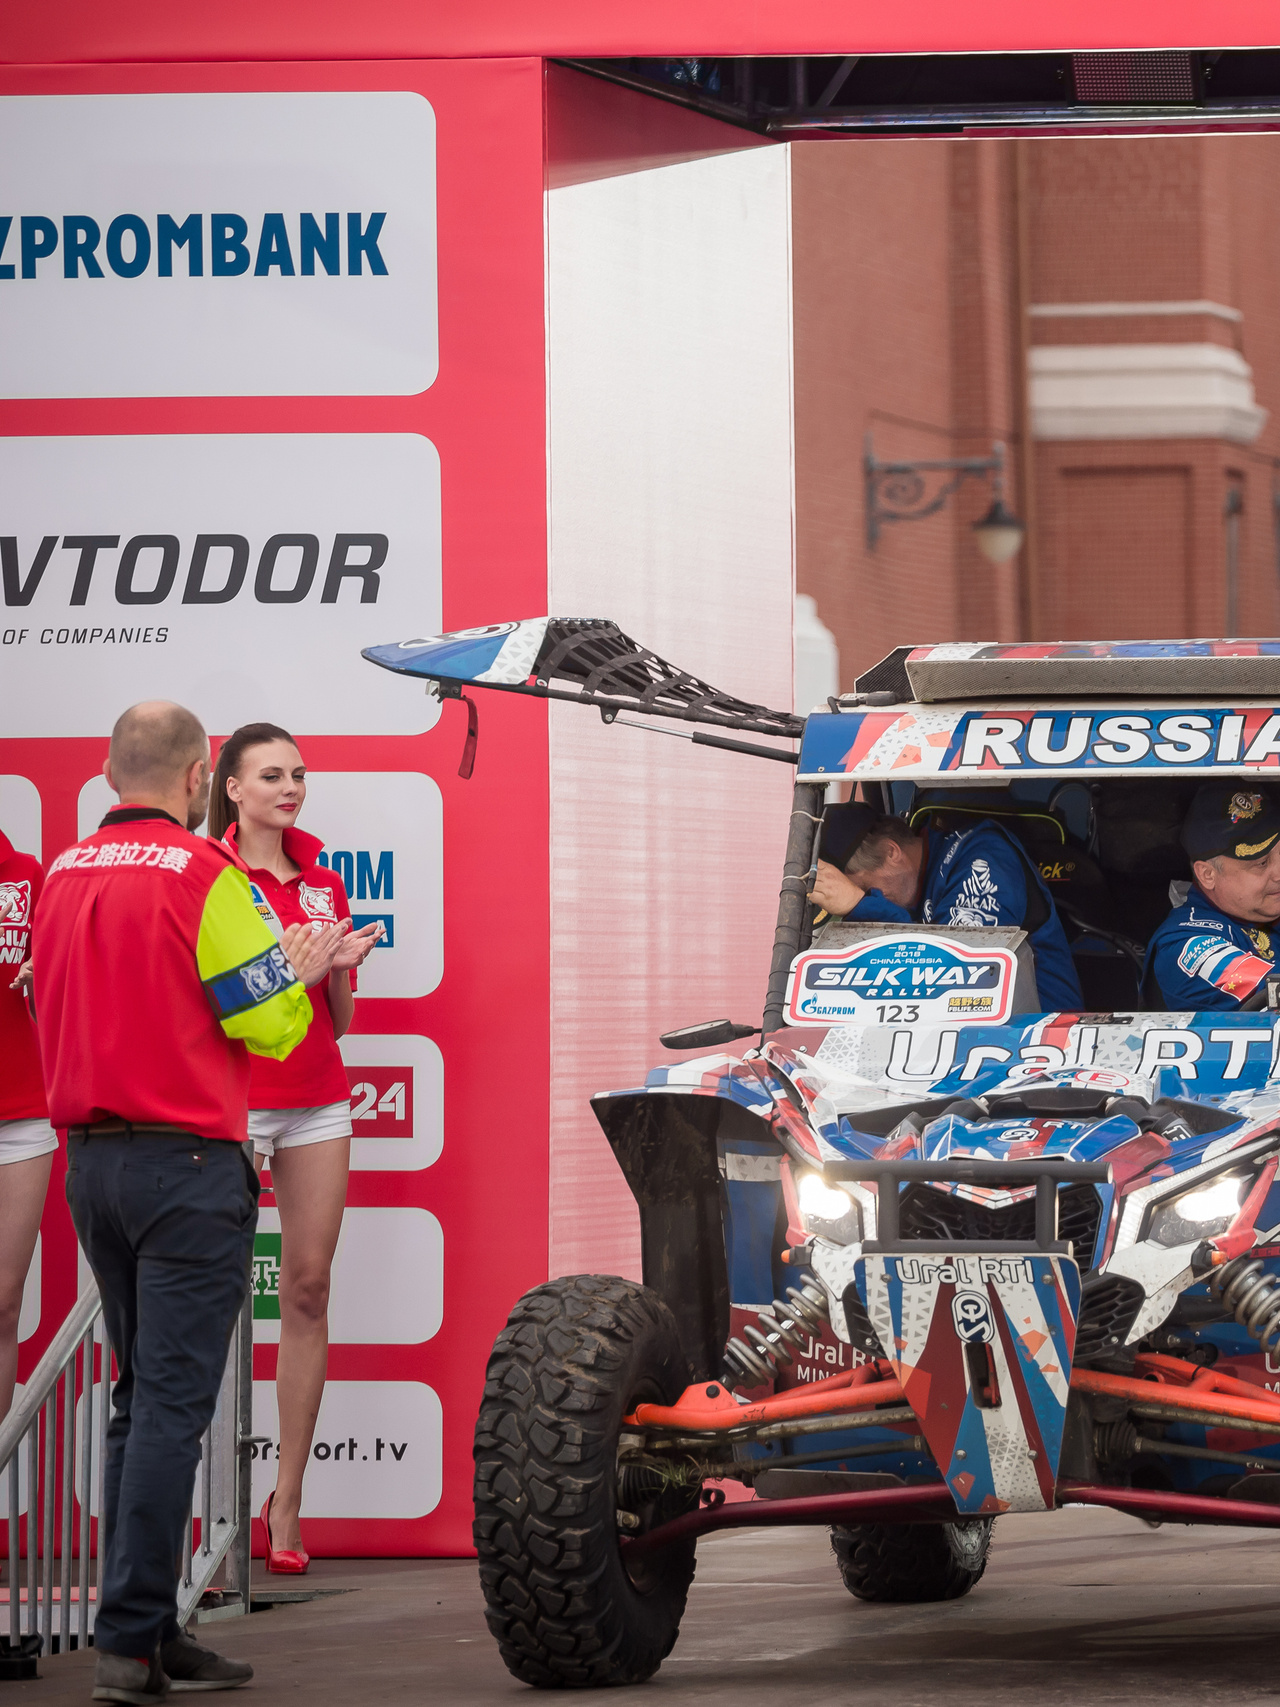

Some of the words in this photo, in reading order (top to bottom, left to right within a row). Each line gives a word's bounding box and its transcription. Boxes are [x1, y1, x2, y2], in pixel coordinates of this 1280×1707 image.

[2, 629, 29, 645] OF
[40, 627, 169, 645] COMPANIES
[956, 893, 1000, 912] DAKAR
[870, 957, 943, 965] CHINA-RUSSIA
[813, 967, 907, 986] SILK
[911, 966, 991, 985] WAY
[865, 987, 936, 996] RALLY
[817, 1006, 855, 1015] GAZPROM
[876, 1005, 920, 1023] 123
[885, 1028, 1099, 1082] Ural
[351, 1082, 405, 1120] 24
[895, 1258, 971, 1284] Ural
[979, 1259, 1035, 1284] RTI
